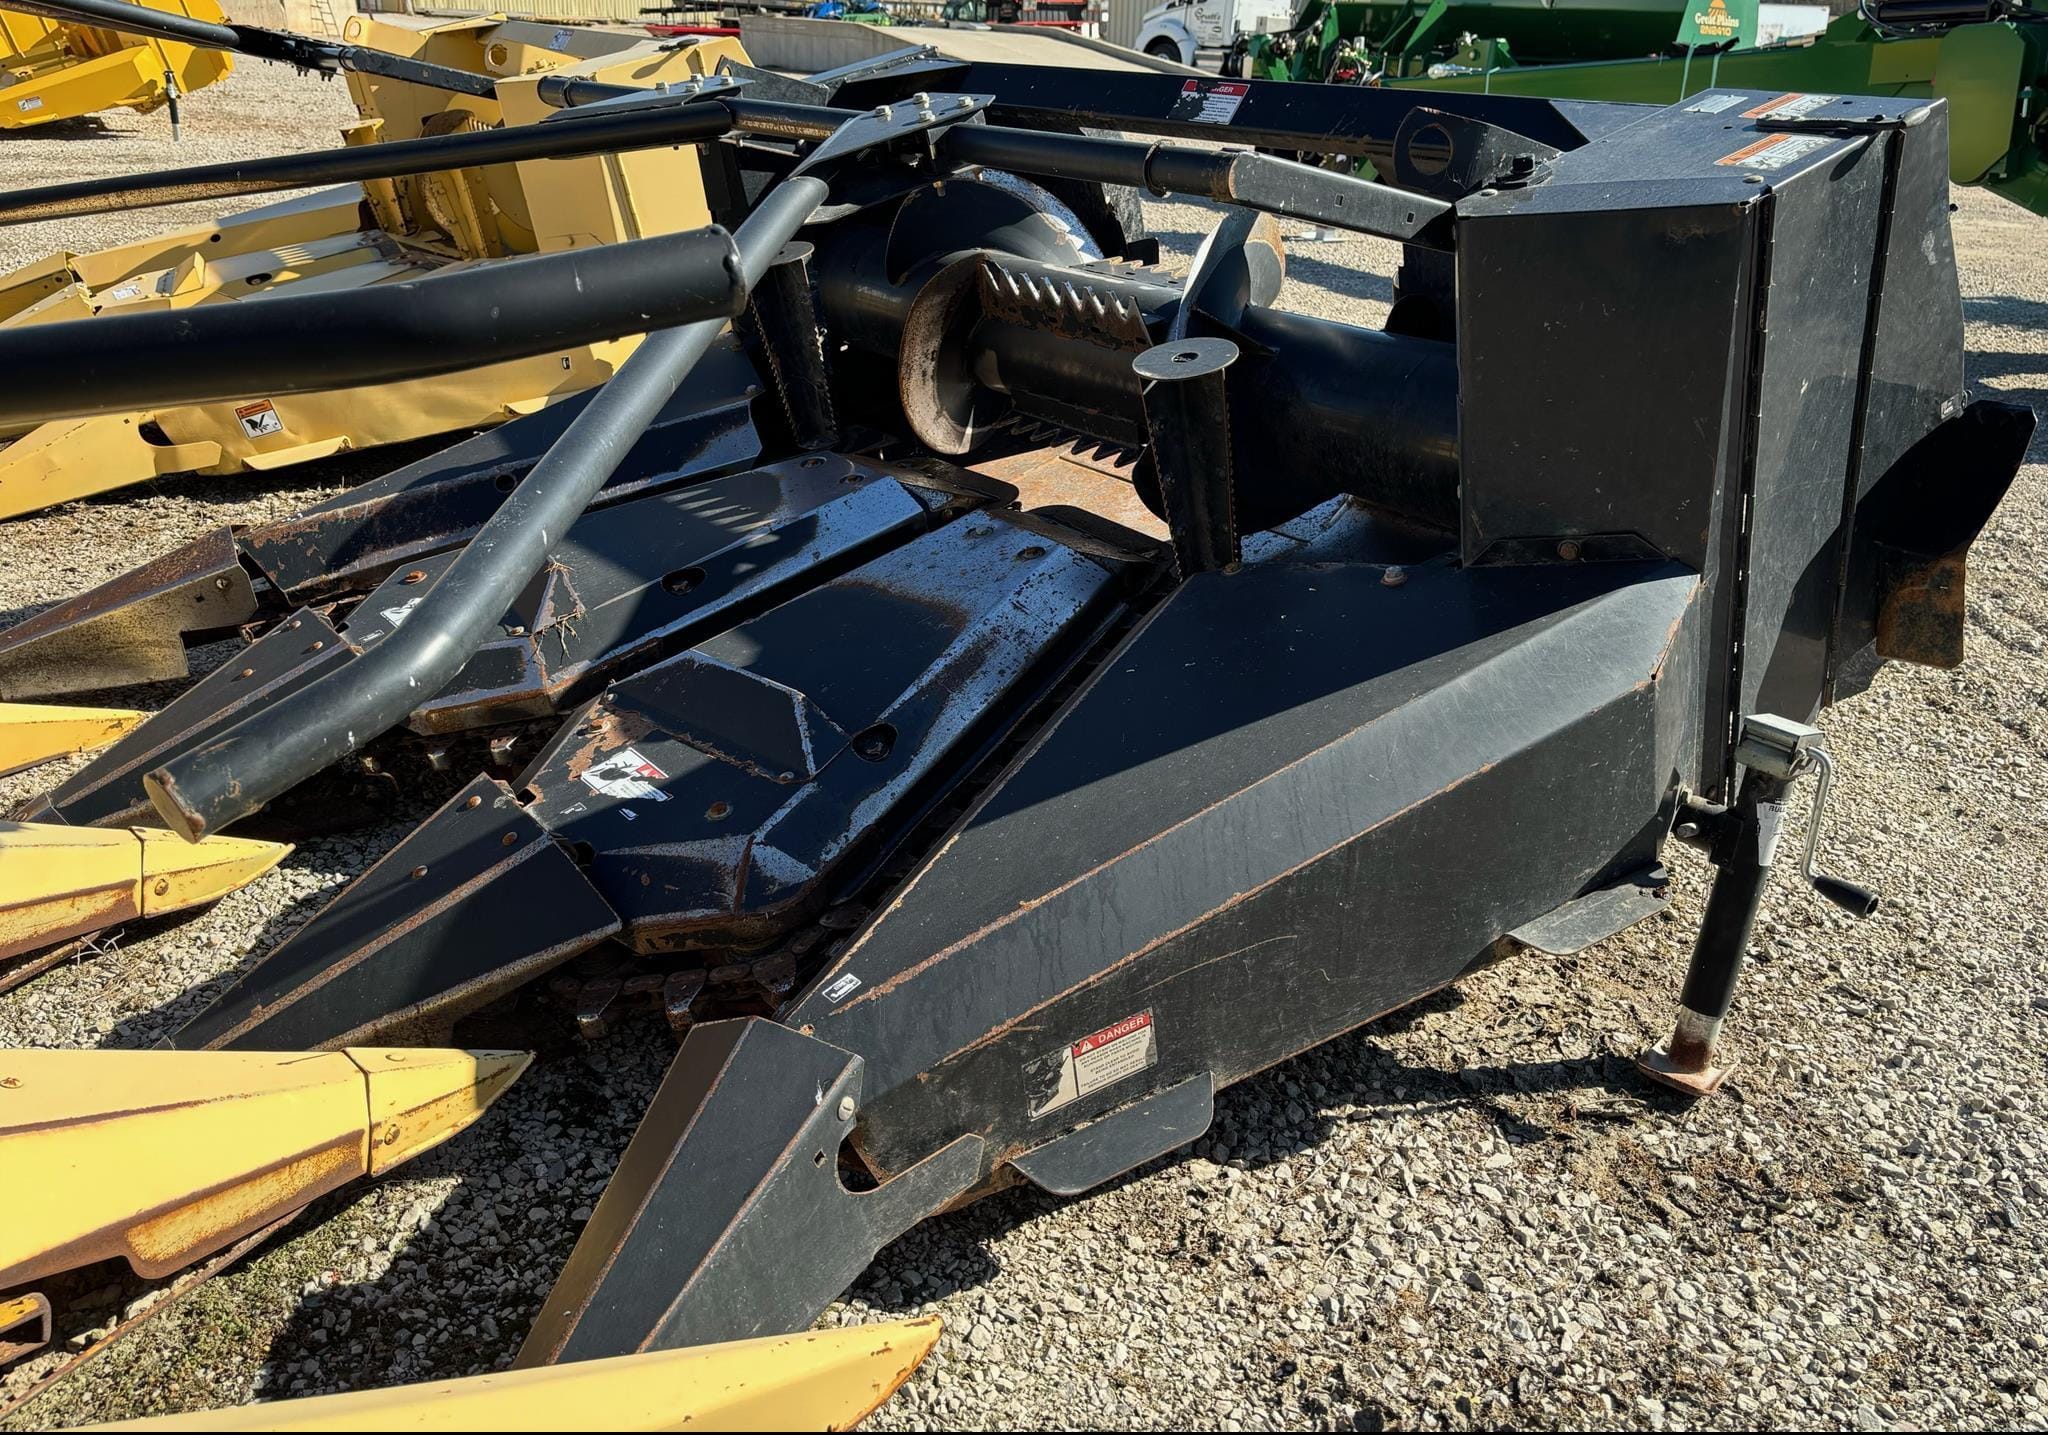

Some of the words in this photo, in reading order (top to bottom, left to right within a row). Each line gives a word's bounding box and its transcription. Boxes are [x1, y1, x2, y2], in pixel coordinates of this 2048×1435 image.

[1695, 12, 1716, 25] Great
[1717, 15, 1739, 27] Plains
[1098, 1017, 1143, 1043] DANGER
